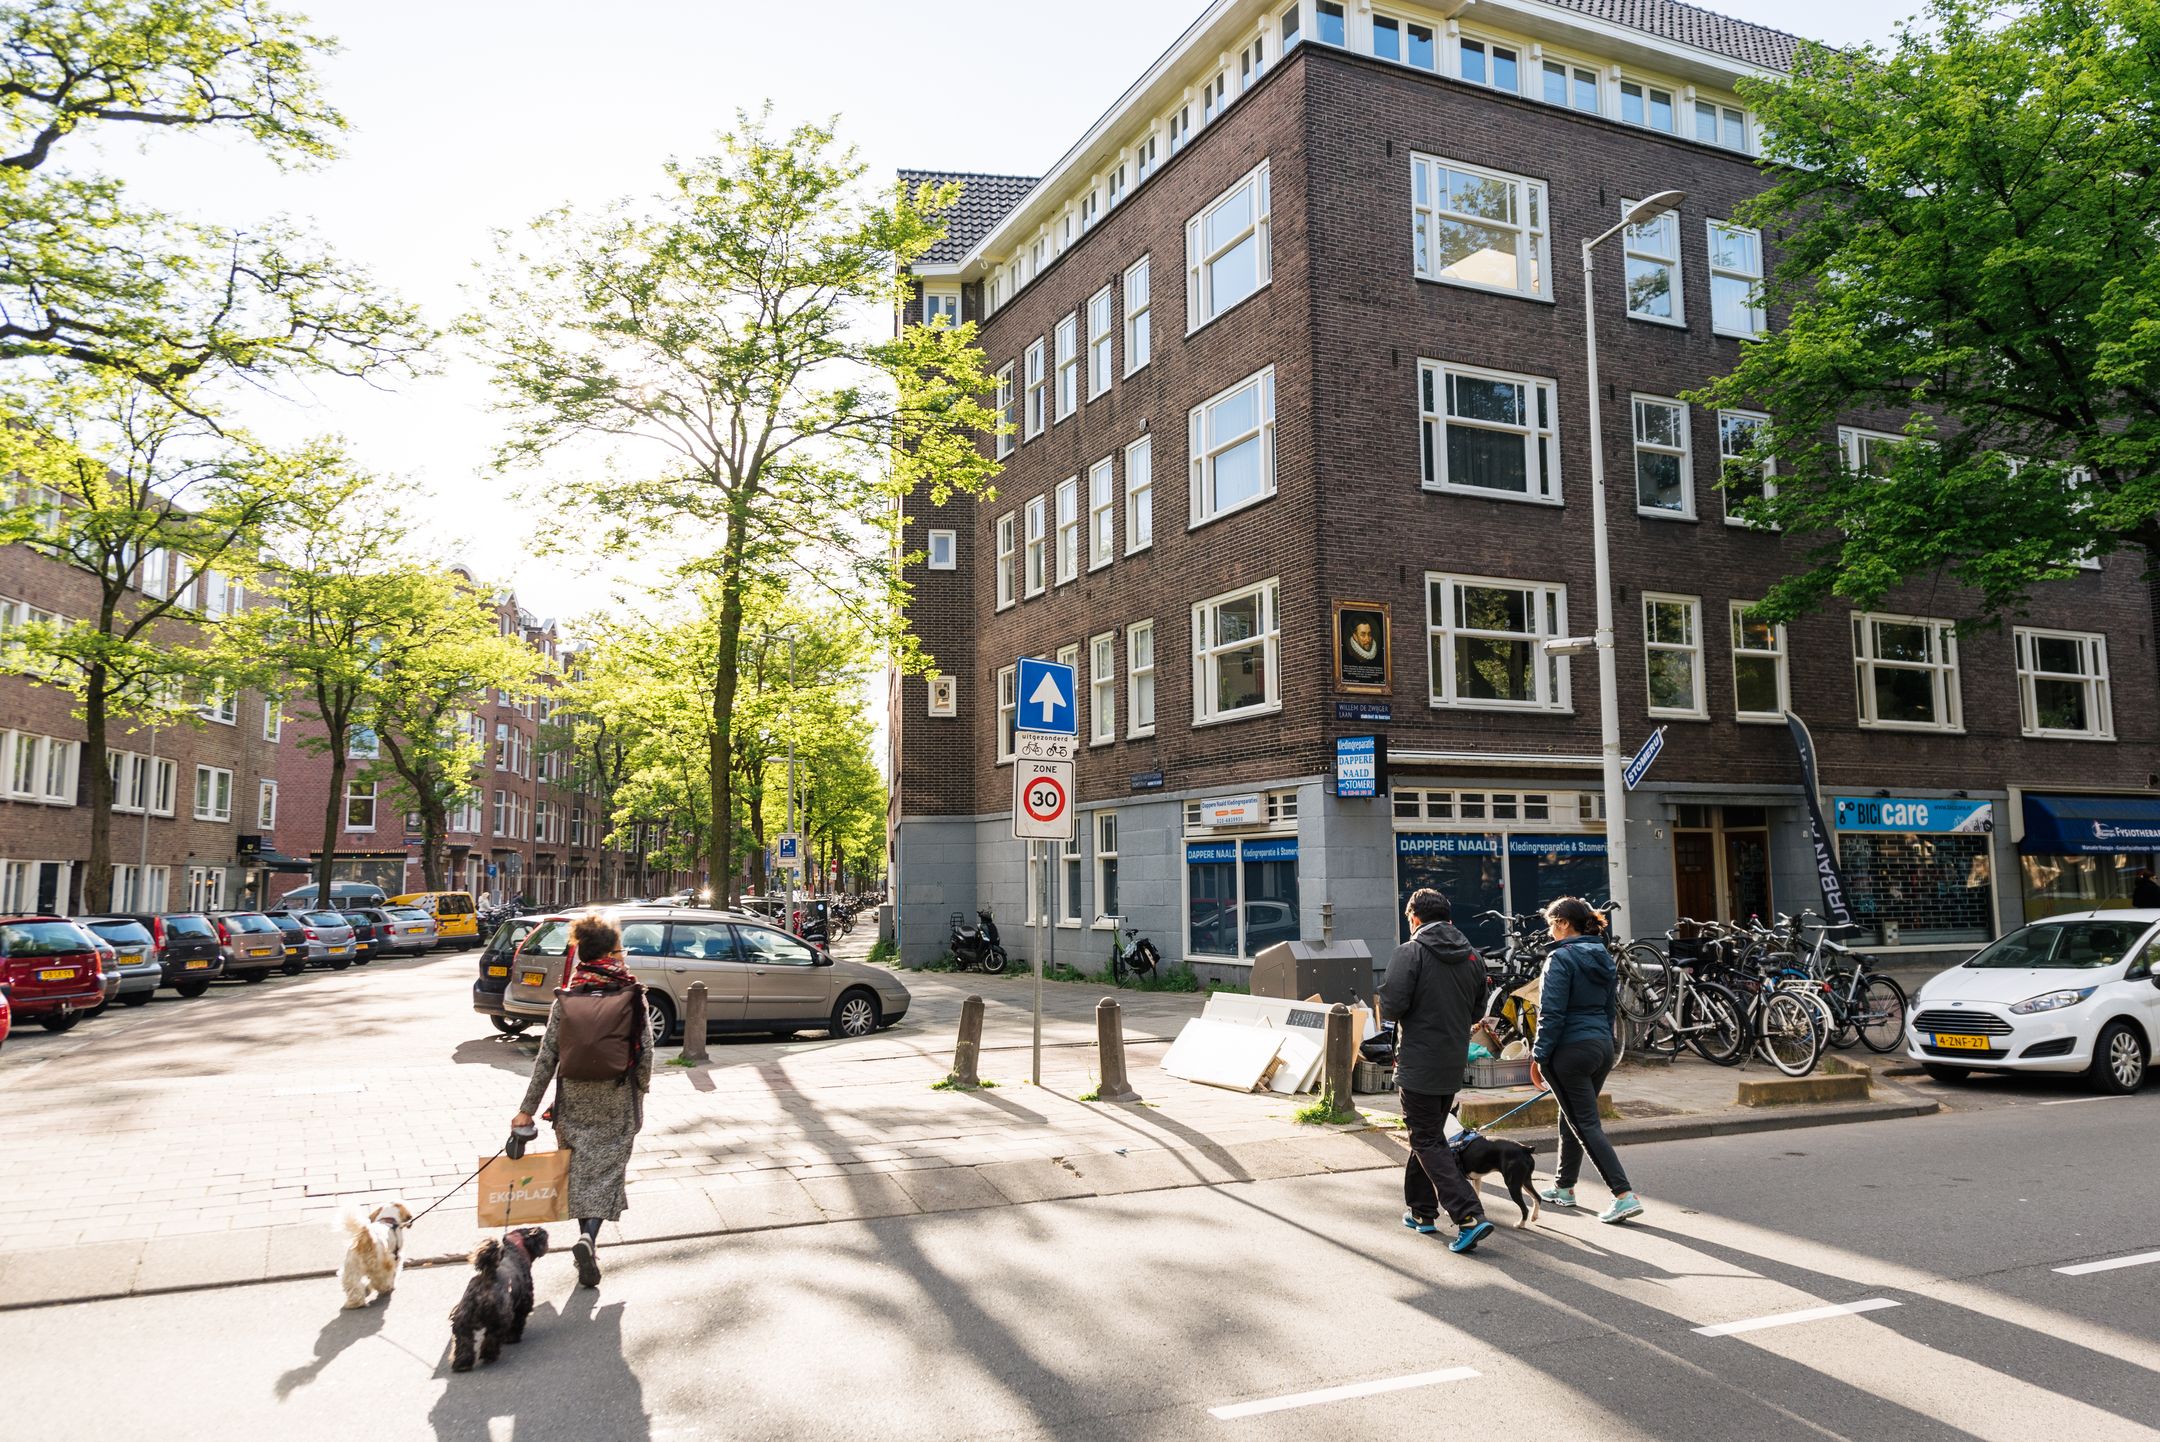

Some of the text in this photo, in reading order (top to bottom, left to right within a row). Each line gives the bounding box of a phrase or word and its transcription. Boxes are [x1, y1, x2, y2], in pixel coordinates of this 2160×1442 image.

[1022, 734, 1068, 742] uitgezonderd
[1339, 755, 1373, 765] DAPPERE
[1033, 765, 1057, 773] ZONE
[1343, 769, 1369, 777] NAALD
[1345, 780, 1375, 790] STOMERIJ
[1032, 791, 1057, 807] 30
[1400, 840, 1497, 851] DAPPERE NAALD
[1509, 841, 1570, 853] Kledingreparatie
[1571, 842, 1577, 851] &
[1187, 849, 1236, 859] DAPPERE NAALD
[1243, 848, 1276, 859] Kledingreparatie
[1814, 843, 1850, 925] URBAN
[1939, 1036, 1984, 1047] 4-ZNF-27
[488, 1187, 558, 1204] EKOPLAZA
